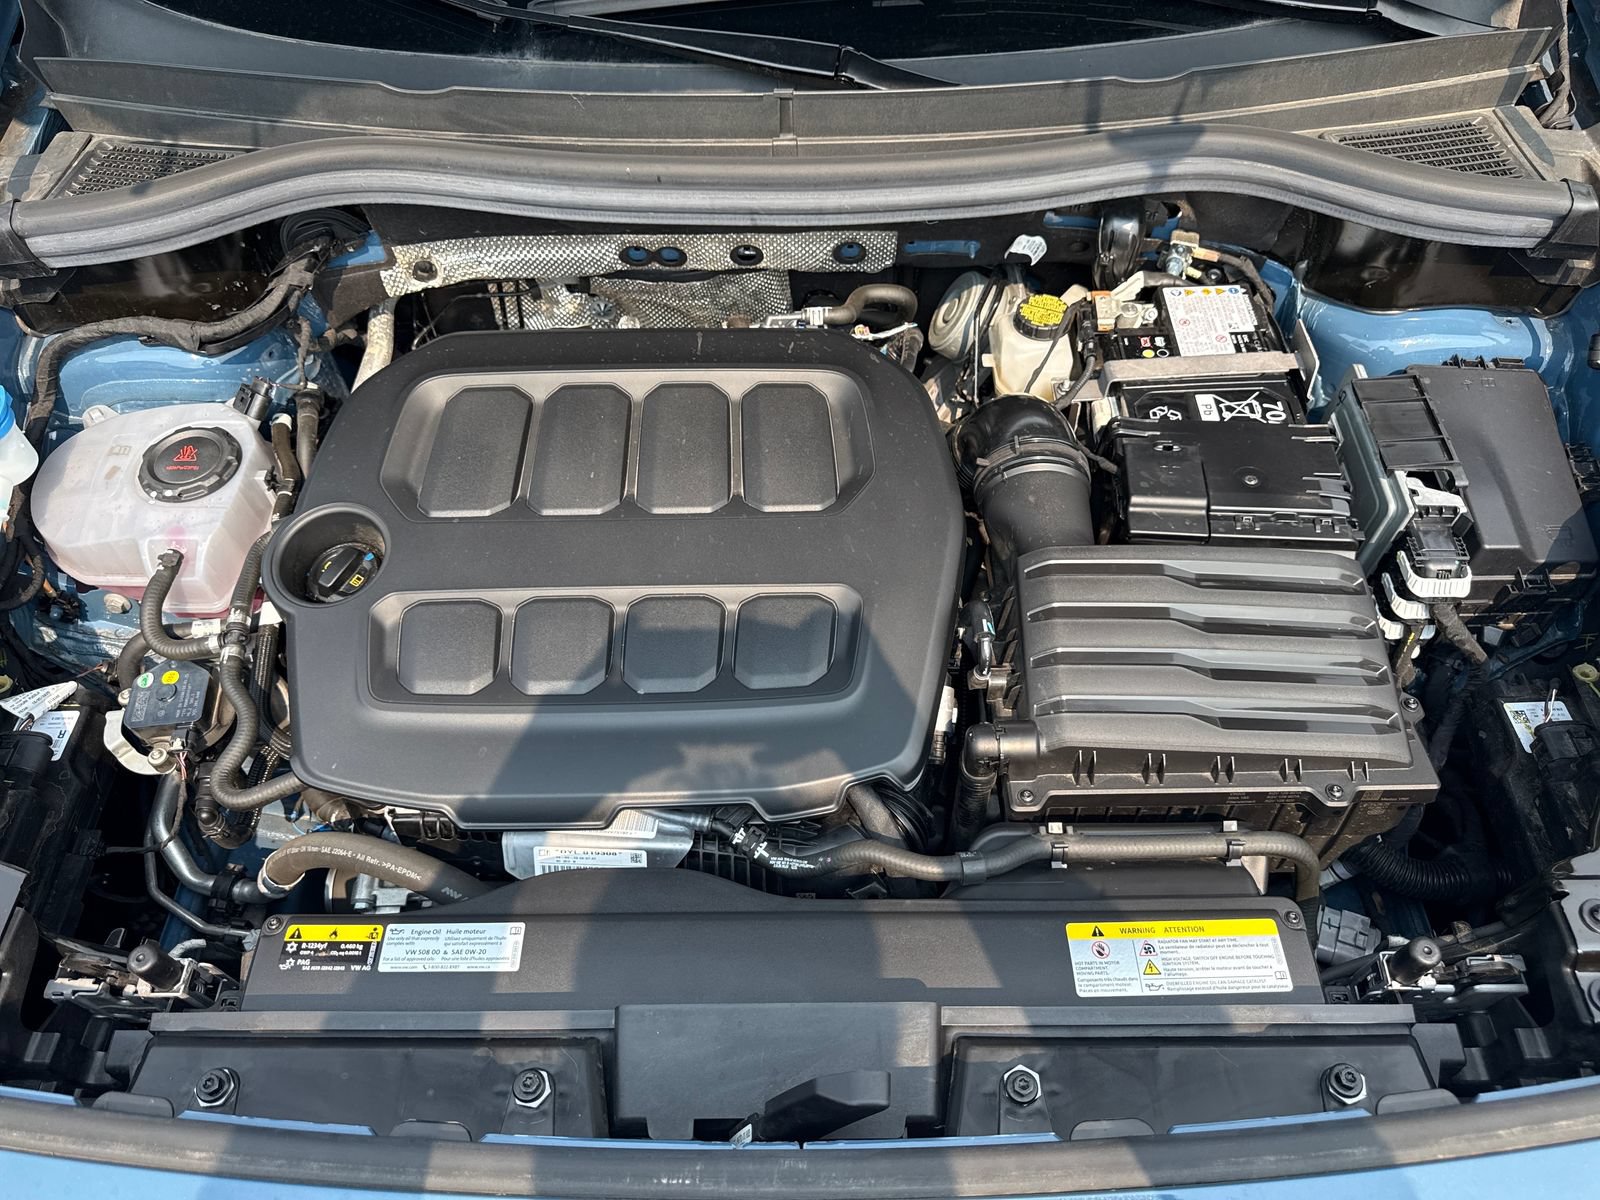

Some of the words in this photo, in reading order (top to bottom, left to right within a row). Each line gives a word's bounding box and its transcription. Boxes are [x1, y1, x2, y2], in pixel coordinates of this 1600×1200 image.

[1201, 403, 1214, 416] Pb
[356, 853, 365, 861] All
[382, 861, 422, 880] >PA-EPDM<
